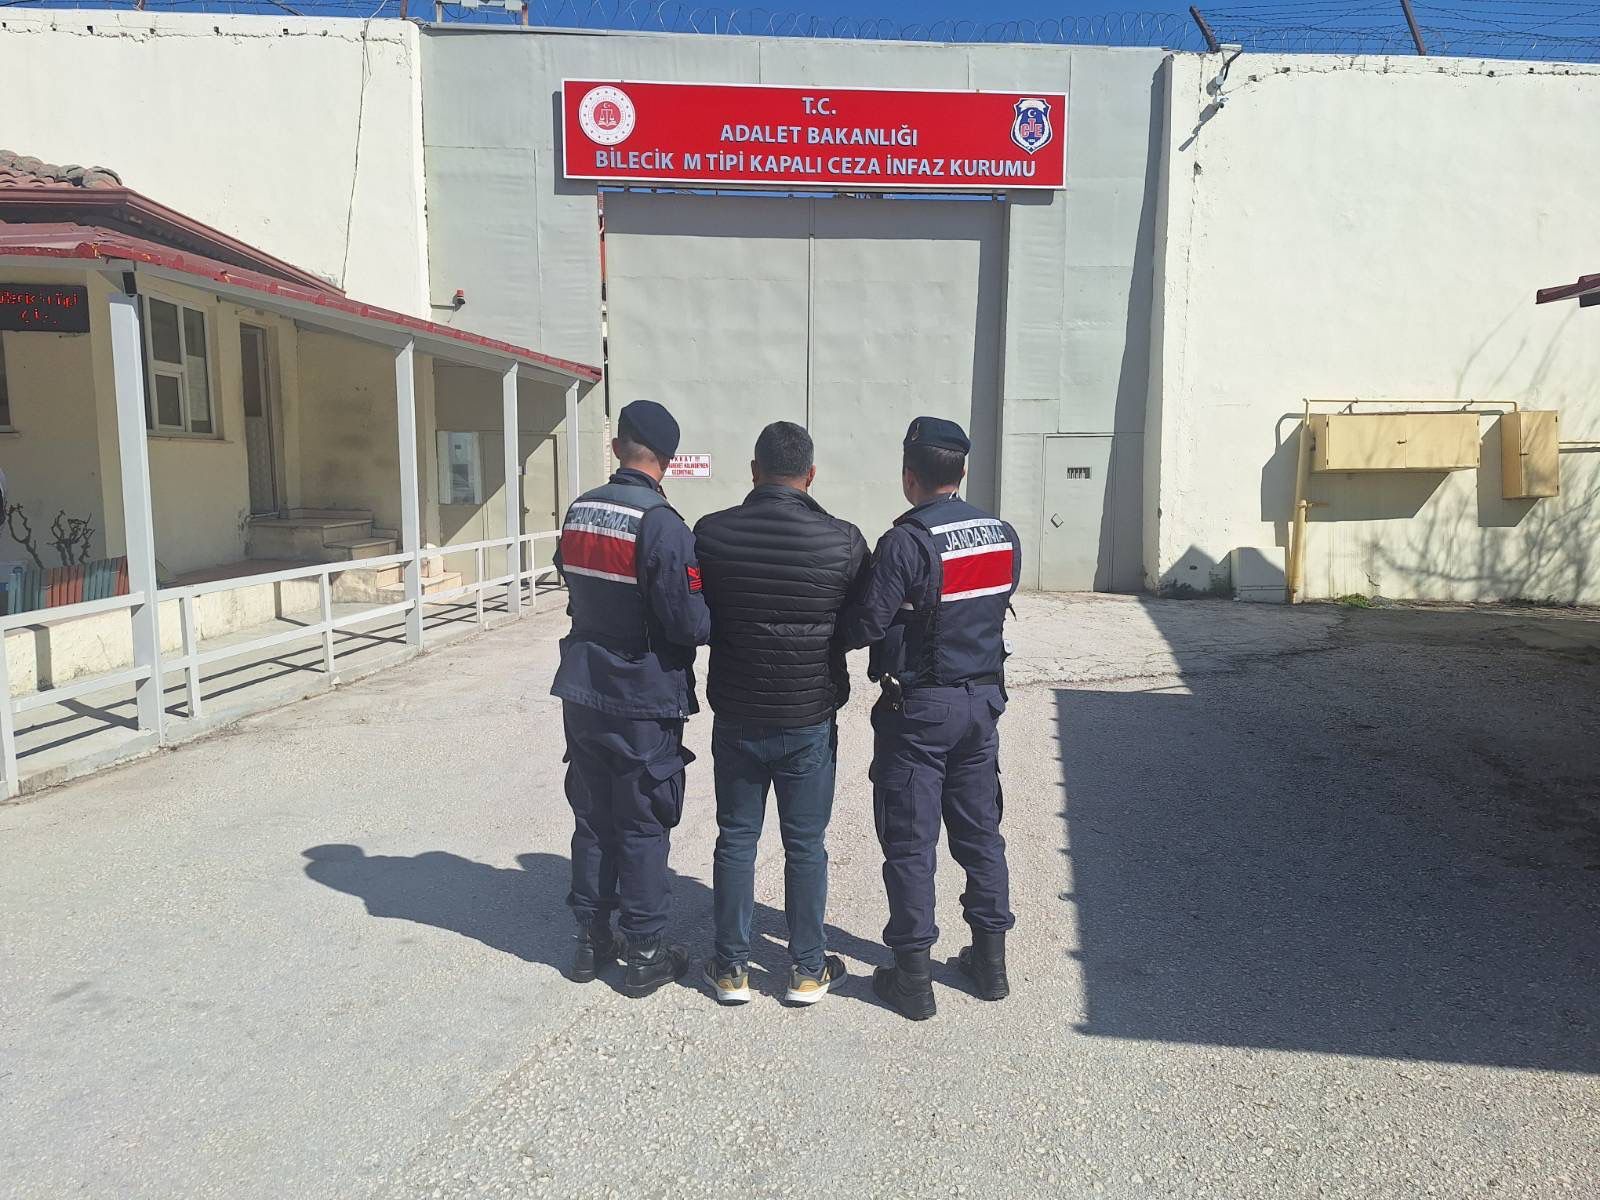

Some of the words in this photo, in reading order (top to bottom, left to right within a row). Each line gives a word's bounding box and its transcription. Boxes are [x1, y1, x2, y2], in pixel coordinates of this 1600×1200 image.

[802, 97, 836, 116] T.C.
[720, 124, 801, 145] ADALET
[807, 124, 918, 147] BAKANLIĞI
[595, 148, 673, 171] BİLECİK
[683, 154, 703, 171] M
[705, 150, 744, 172] TİPİ
[750, 155, 822, 174] KAPALI
[828, 156, 880, 175] CEZA
[886, 154, 944, 176] İNFAZ
[950, 158, 1035, 177] KURUMU
[572, 507, 630, 531] JANDARMA
[945, 526, 1006, 550] JANDARMA
